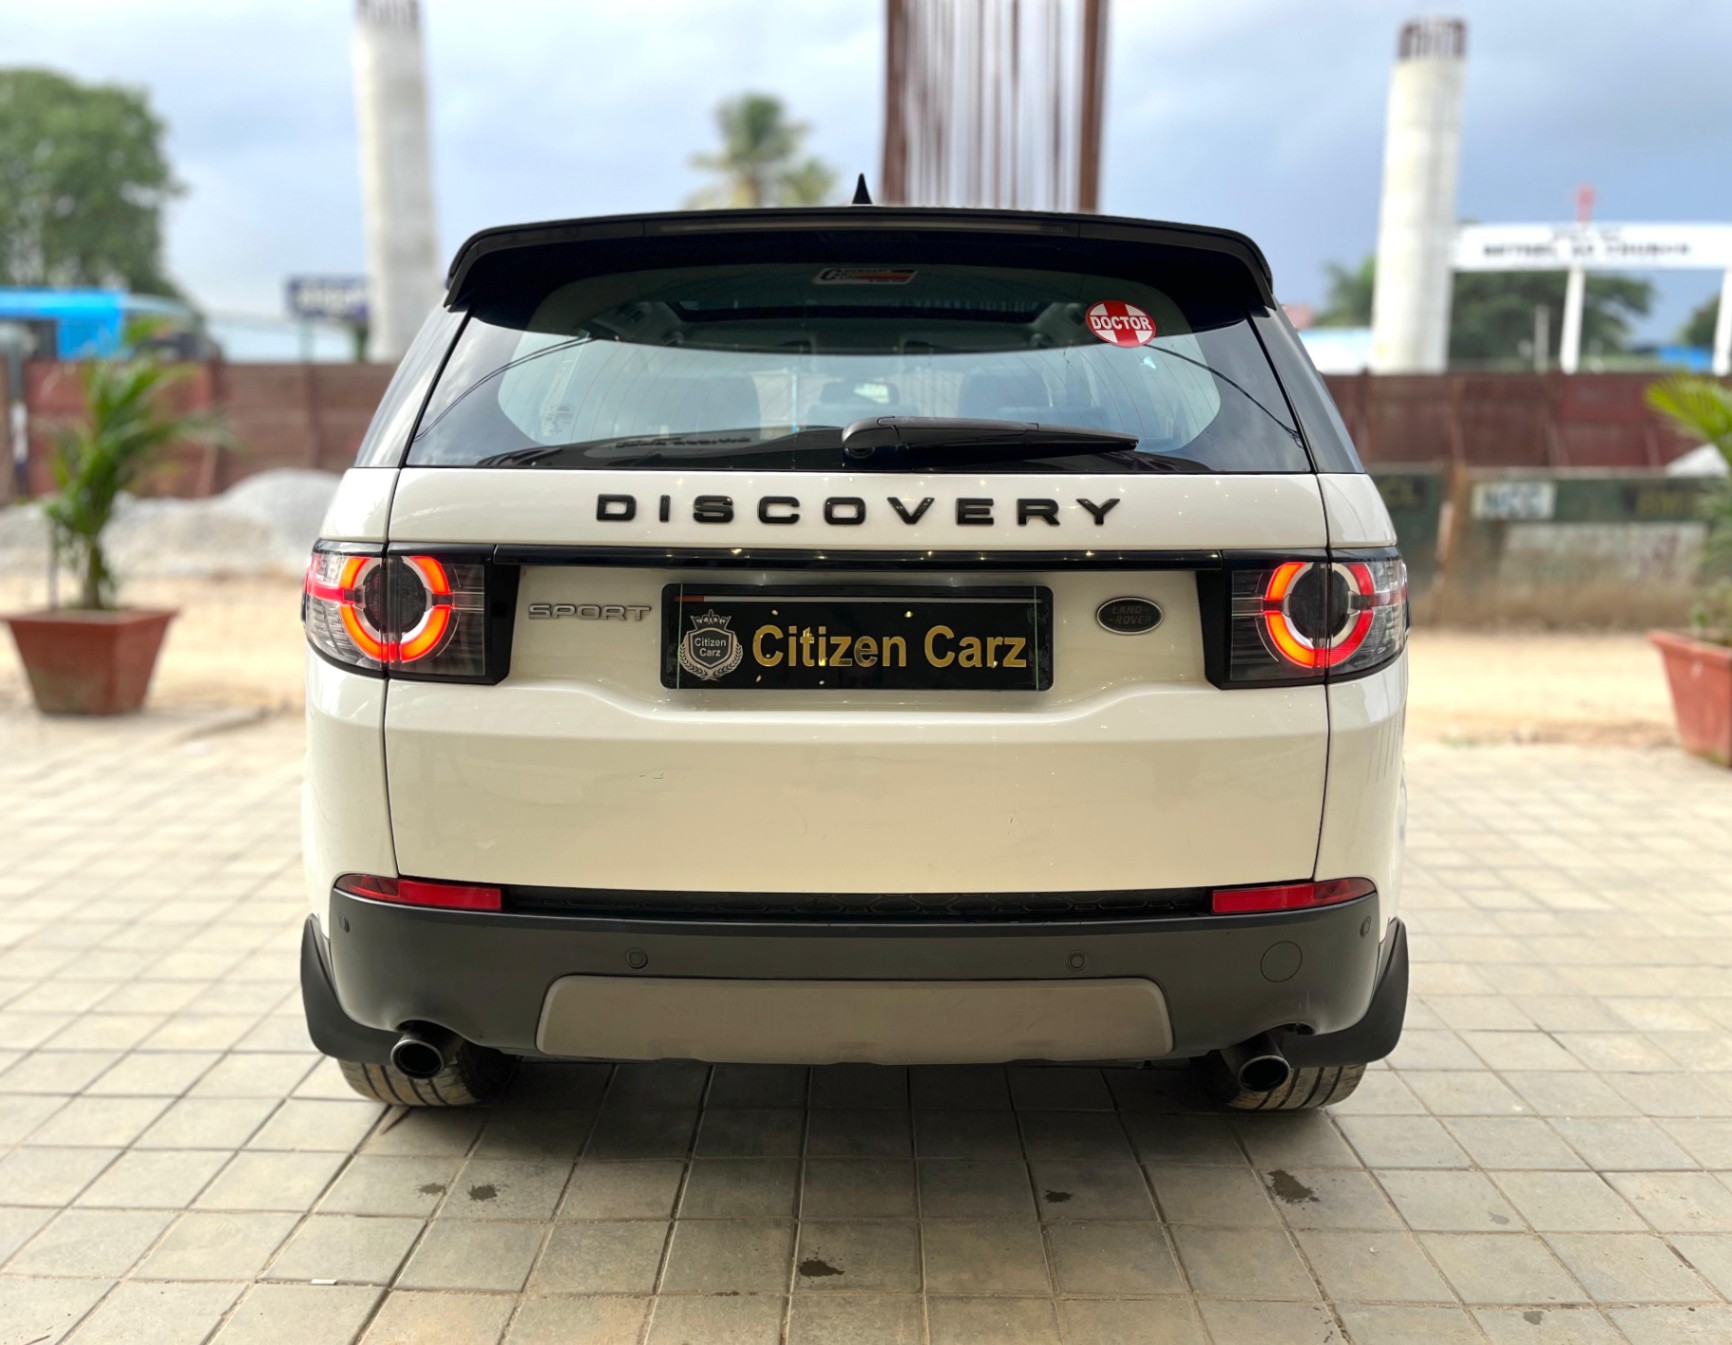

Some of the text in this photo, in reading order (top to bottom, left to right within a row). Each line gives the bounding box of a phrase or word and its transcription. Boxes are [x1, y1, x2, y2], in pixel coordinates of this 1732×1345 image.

[1090, 316, 1153, 330] DOCTOR
[596, 493, 1121, 527] DISCOVERY
[528, 603, 652, 622] SPORT
[694, 637, 727, 647] Citizen
[752, 625, 1027, 668] Citizen Carz
[699, 648, 721, 657] Carz
